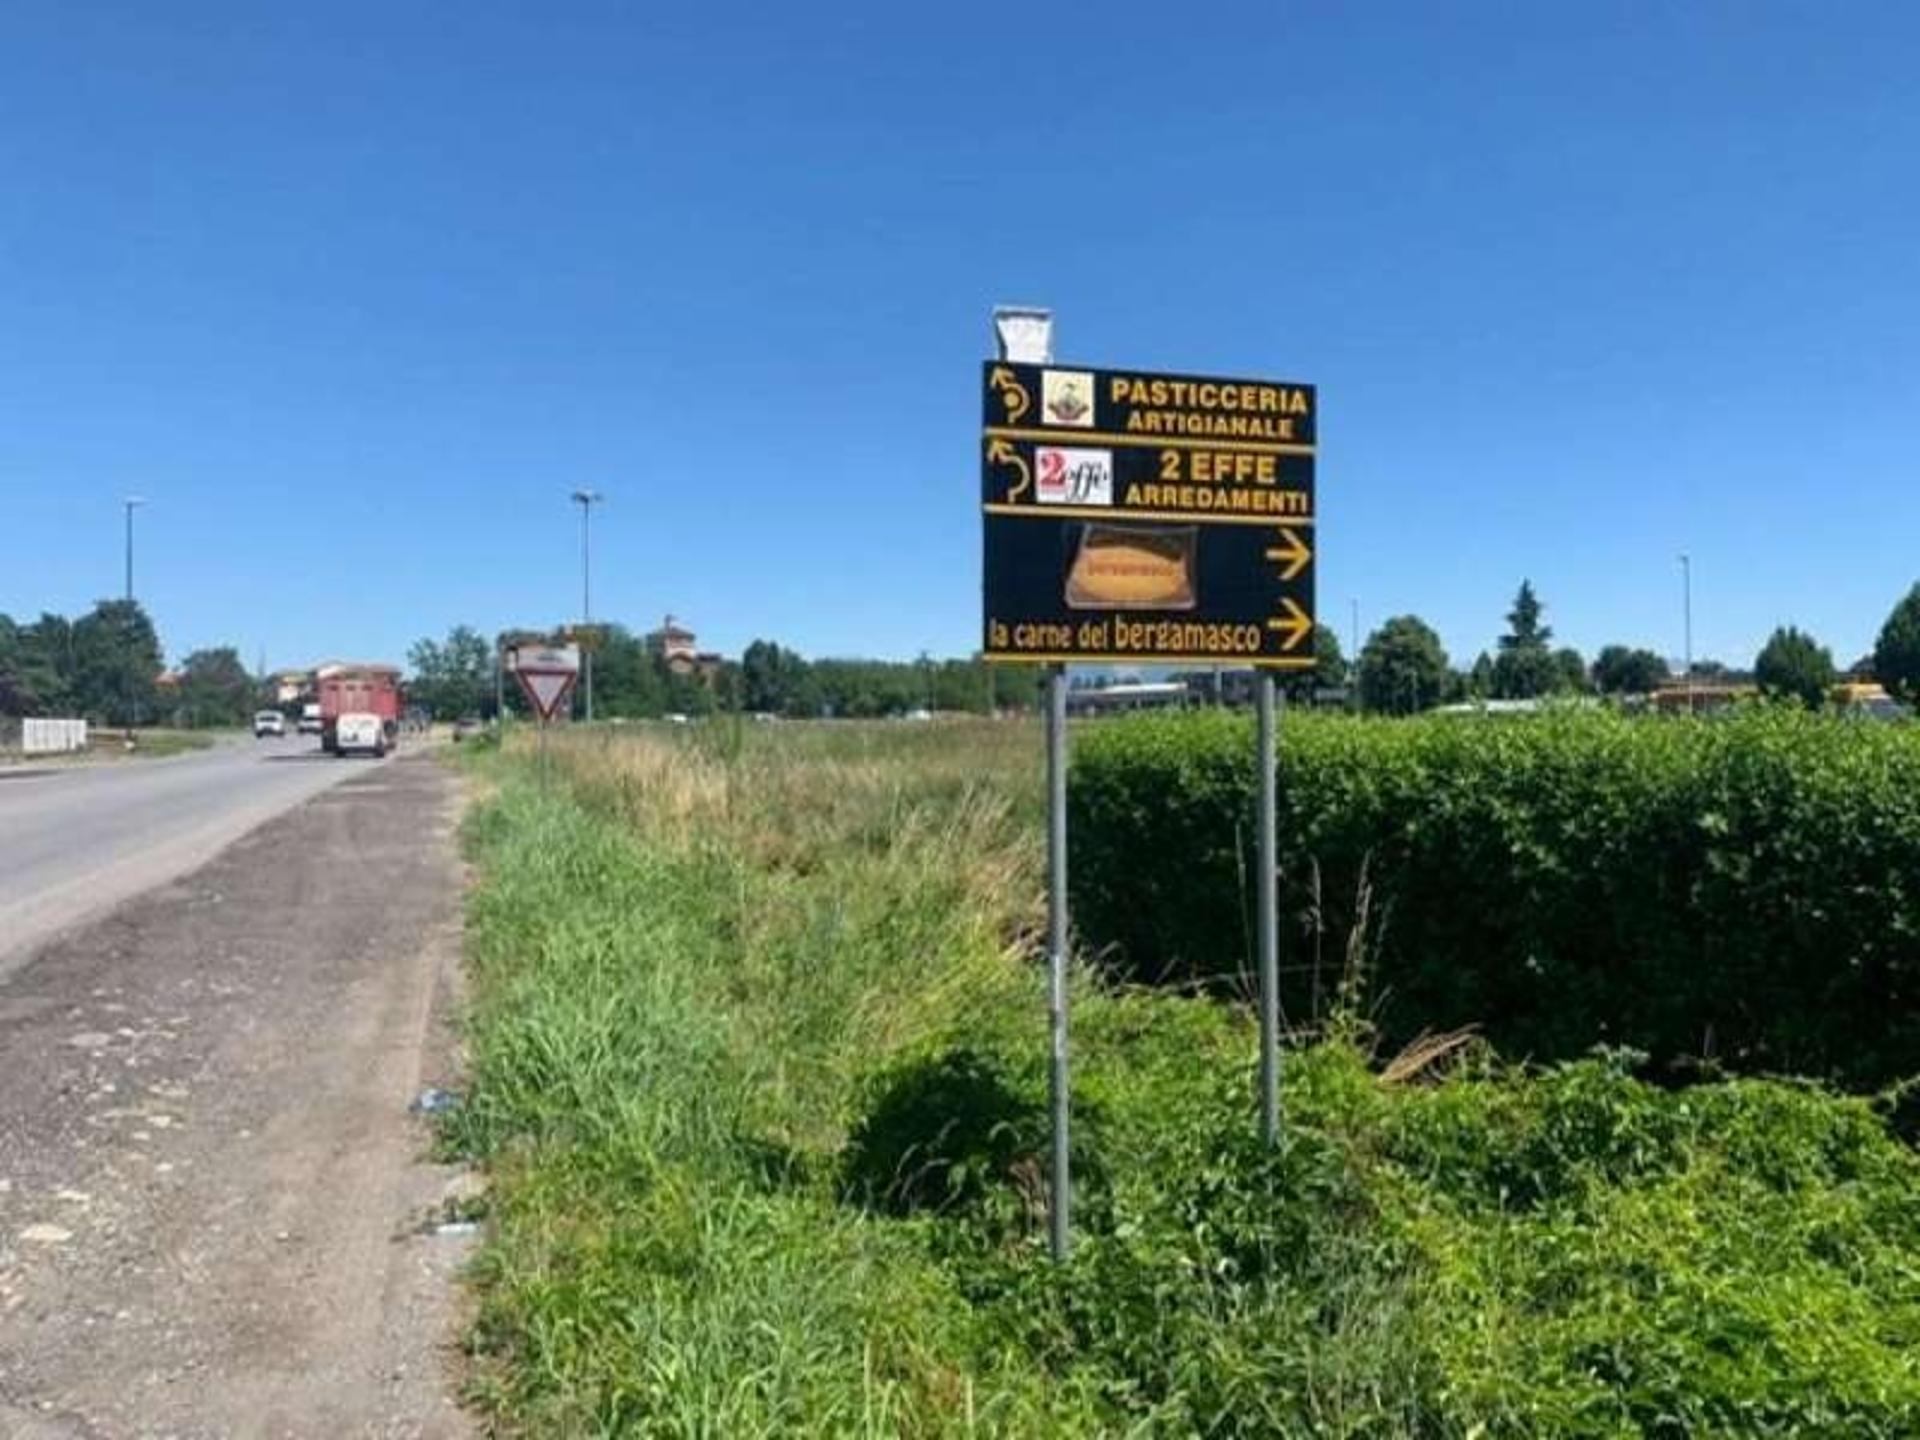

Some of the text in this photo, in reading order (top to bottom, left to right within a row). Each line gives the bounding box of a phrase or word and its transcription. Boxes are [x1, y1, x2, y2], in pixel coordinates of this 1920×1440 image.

[1111, 378, 1307, 414] PASTICCERIA
[1126, 411, 1293, 439] ARTIGIANALE
[1160, 452, 1277, 484] 2 EFFE
[1125, 484, 1308, 514] ARREDAMENTI
[1014, 623, 1072, 649] carne
[1078, 620, 1108, 649] del
[1115, 615, 1261, 652] bergamasco
